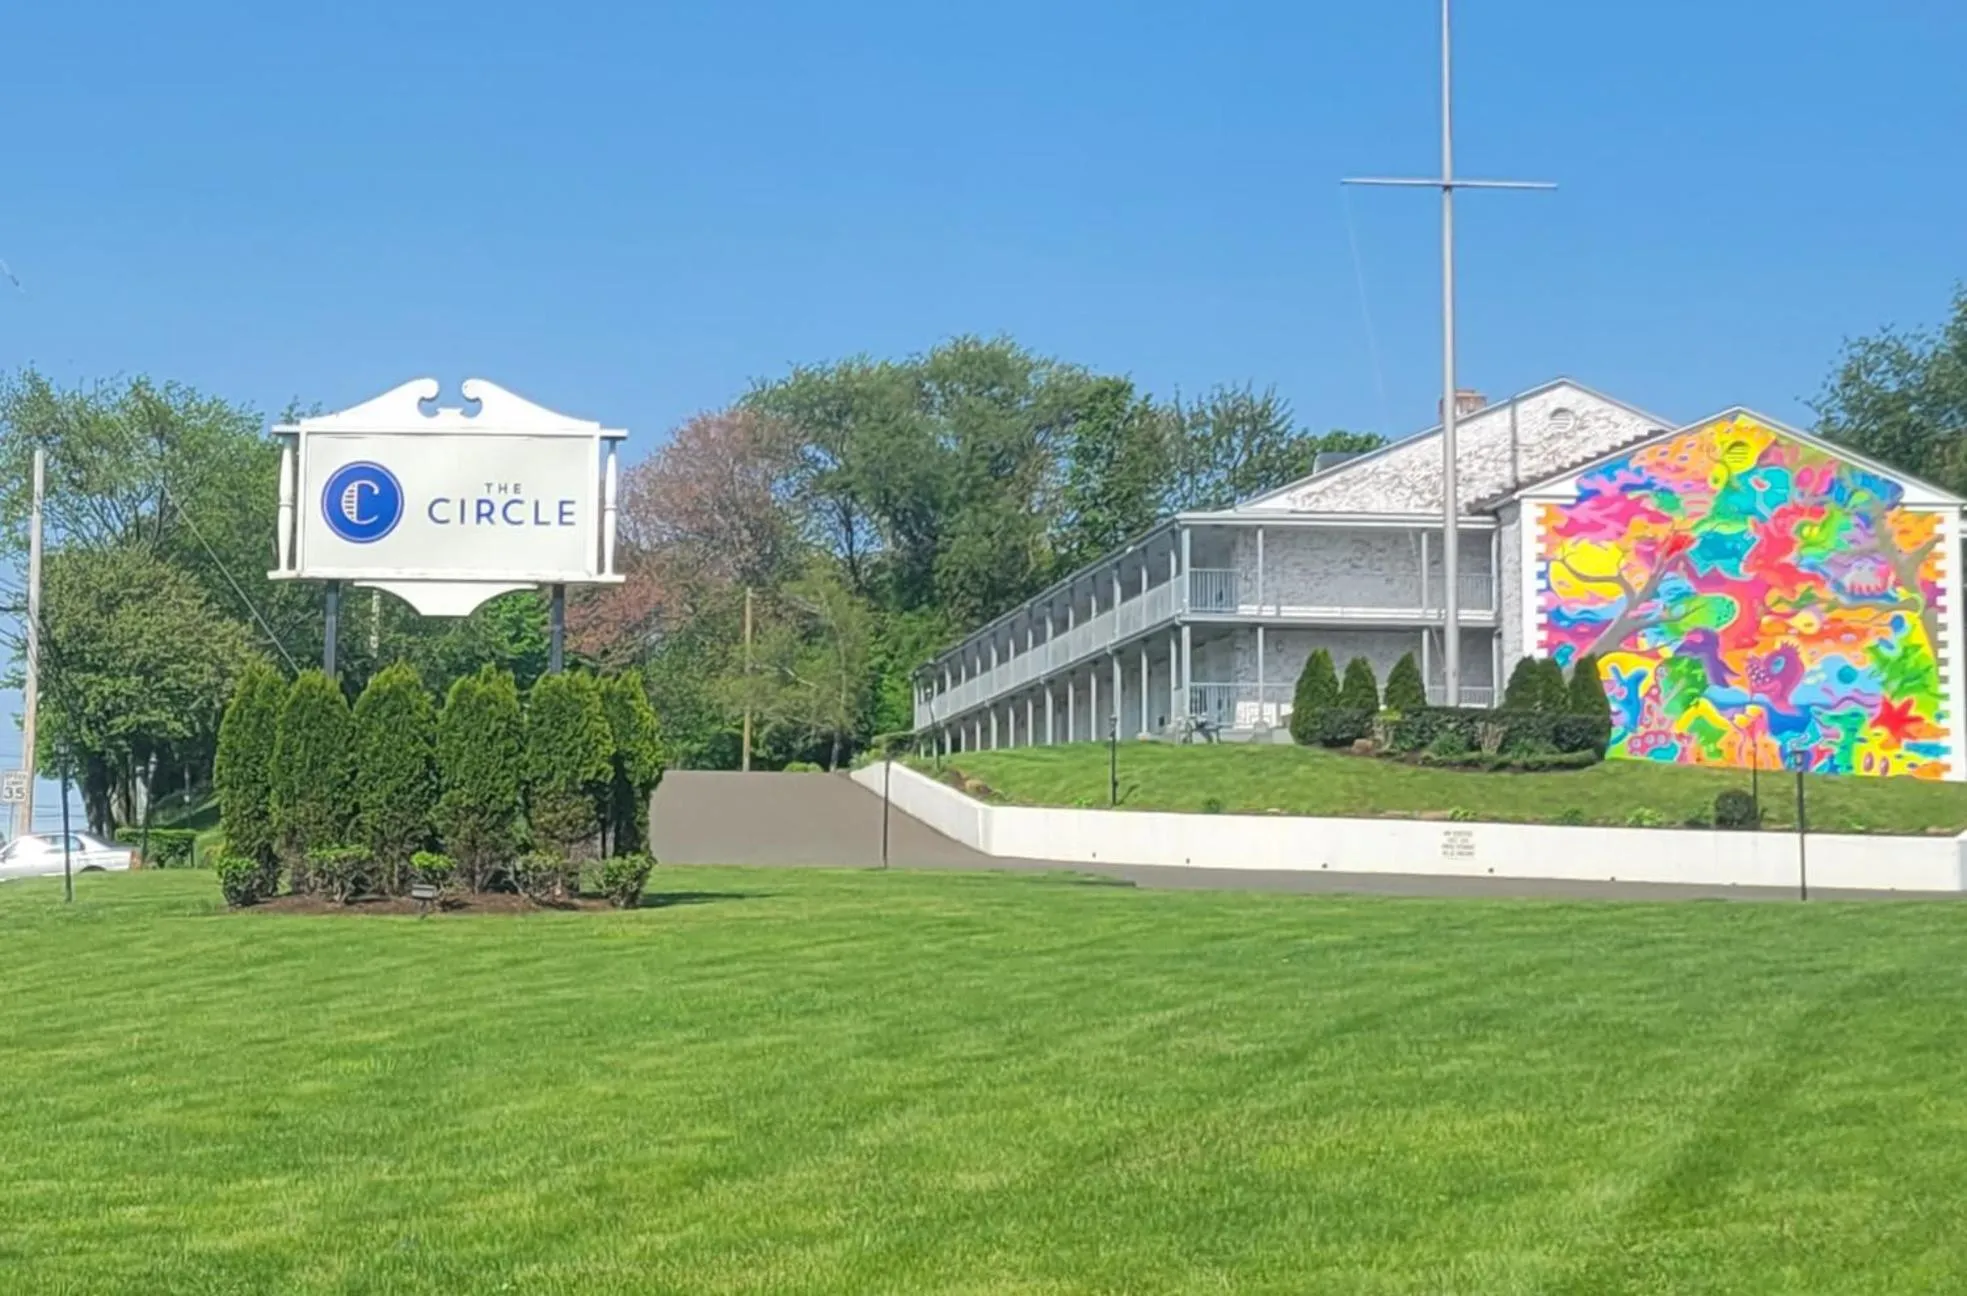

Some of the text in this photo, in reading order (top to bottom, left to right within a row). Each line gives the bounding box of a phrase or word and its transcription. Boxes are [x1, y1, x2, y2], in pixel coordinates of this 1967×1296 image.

[485, 483, 521, 494] THE
[428, 498, 576, 526] CIRCLE
[4, 787, 25, 799] 35
